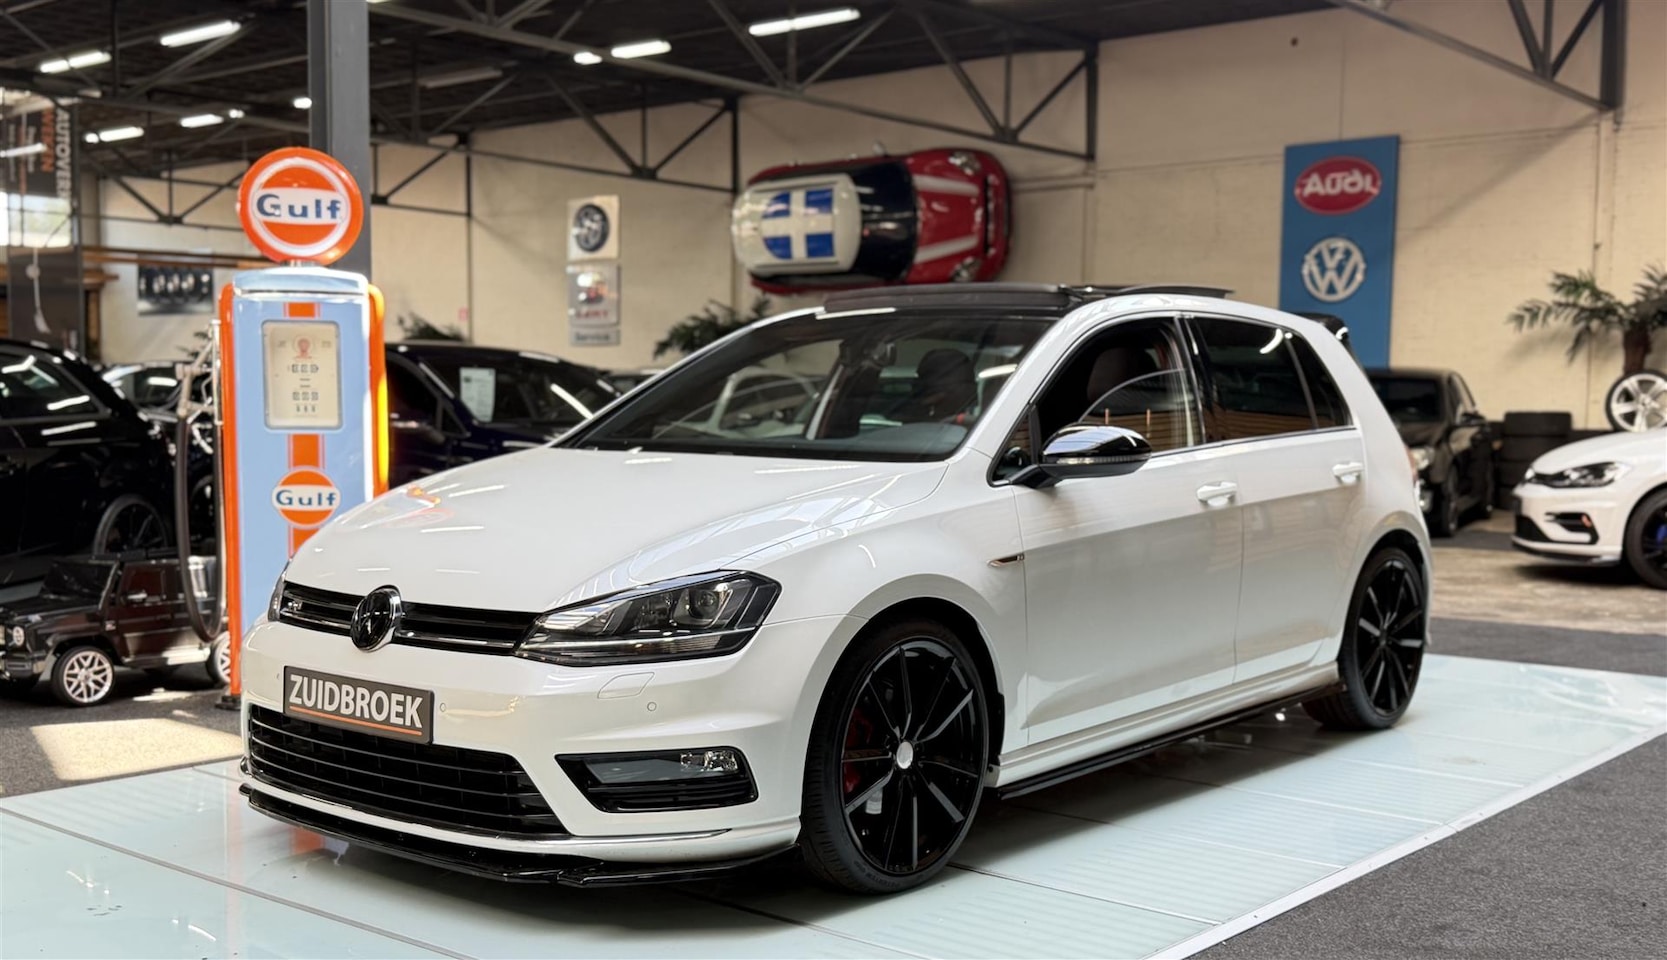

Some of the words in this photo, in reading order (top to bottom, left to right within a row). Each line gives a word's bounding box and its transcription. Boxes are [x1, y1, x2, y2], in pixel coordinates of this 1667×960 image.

[257, 194, 341, 219] Gulf
[276, 490, 336, 506] Gulf
[289, 674, 423, 728] ZUIDBROEK
